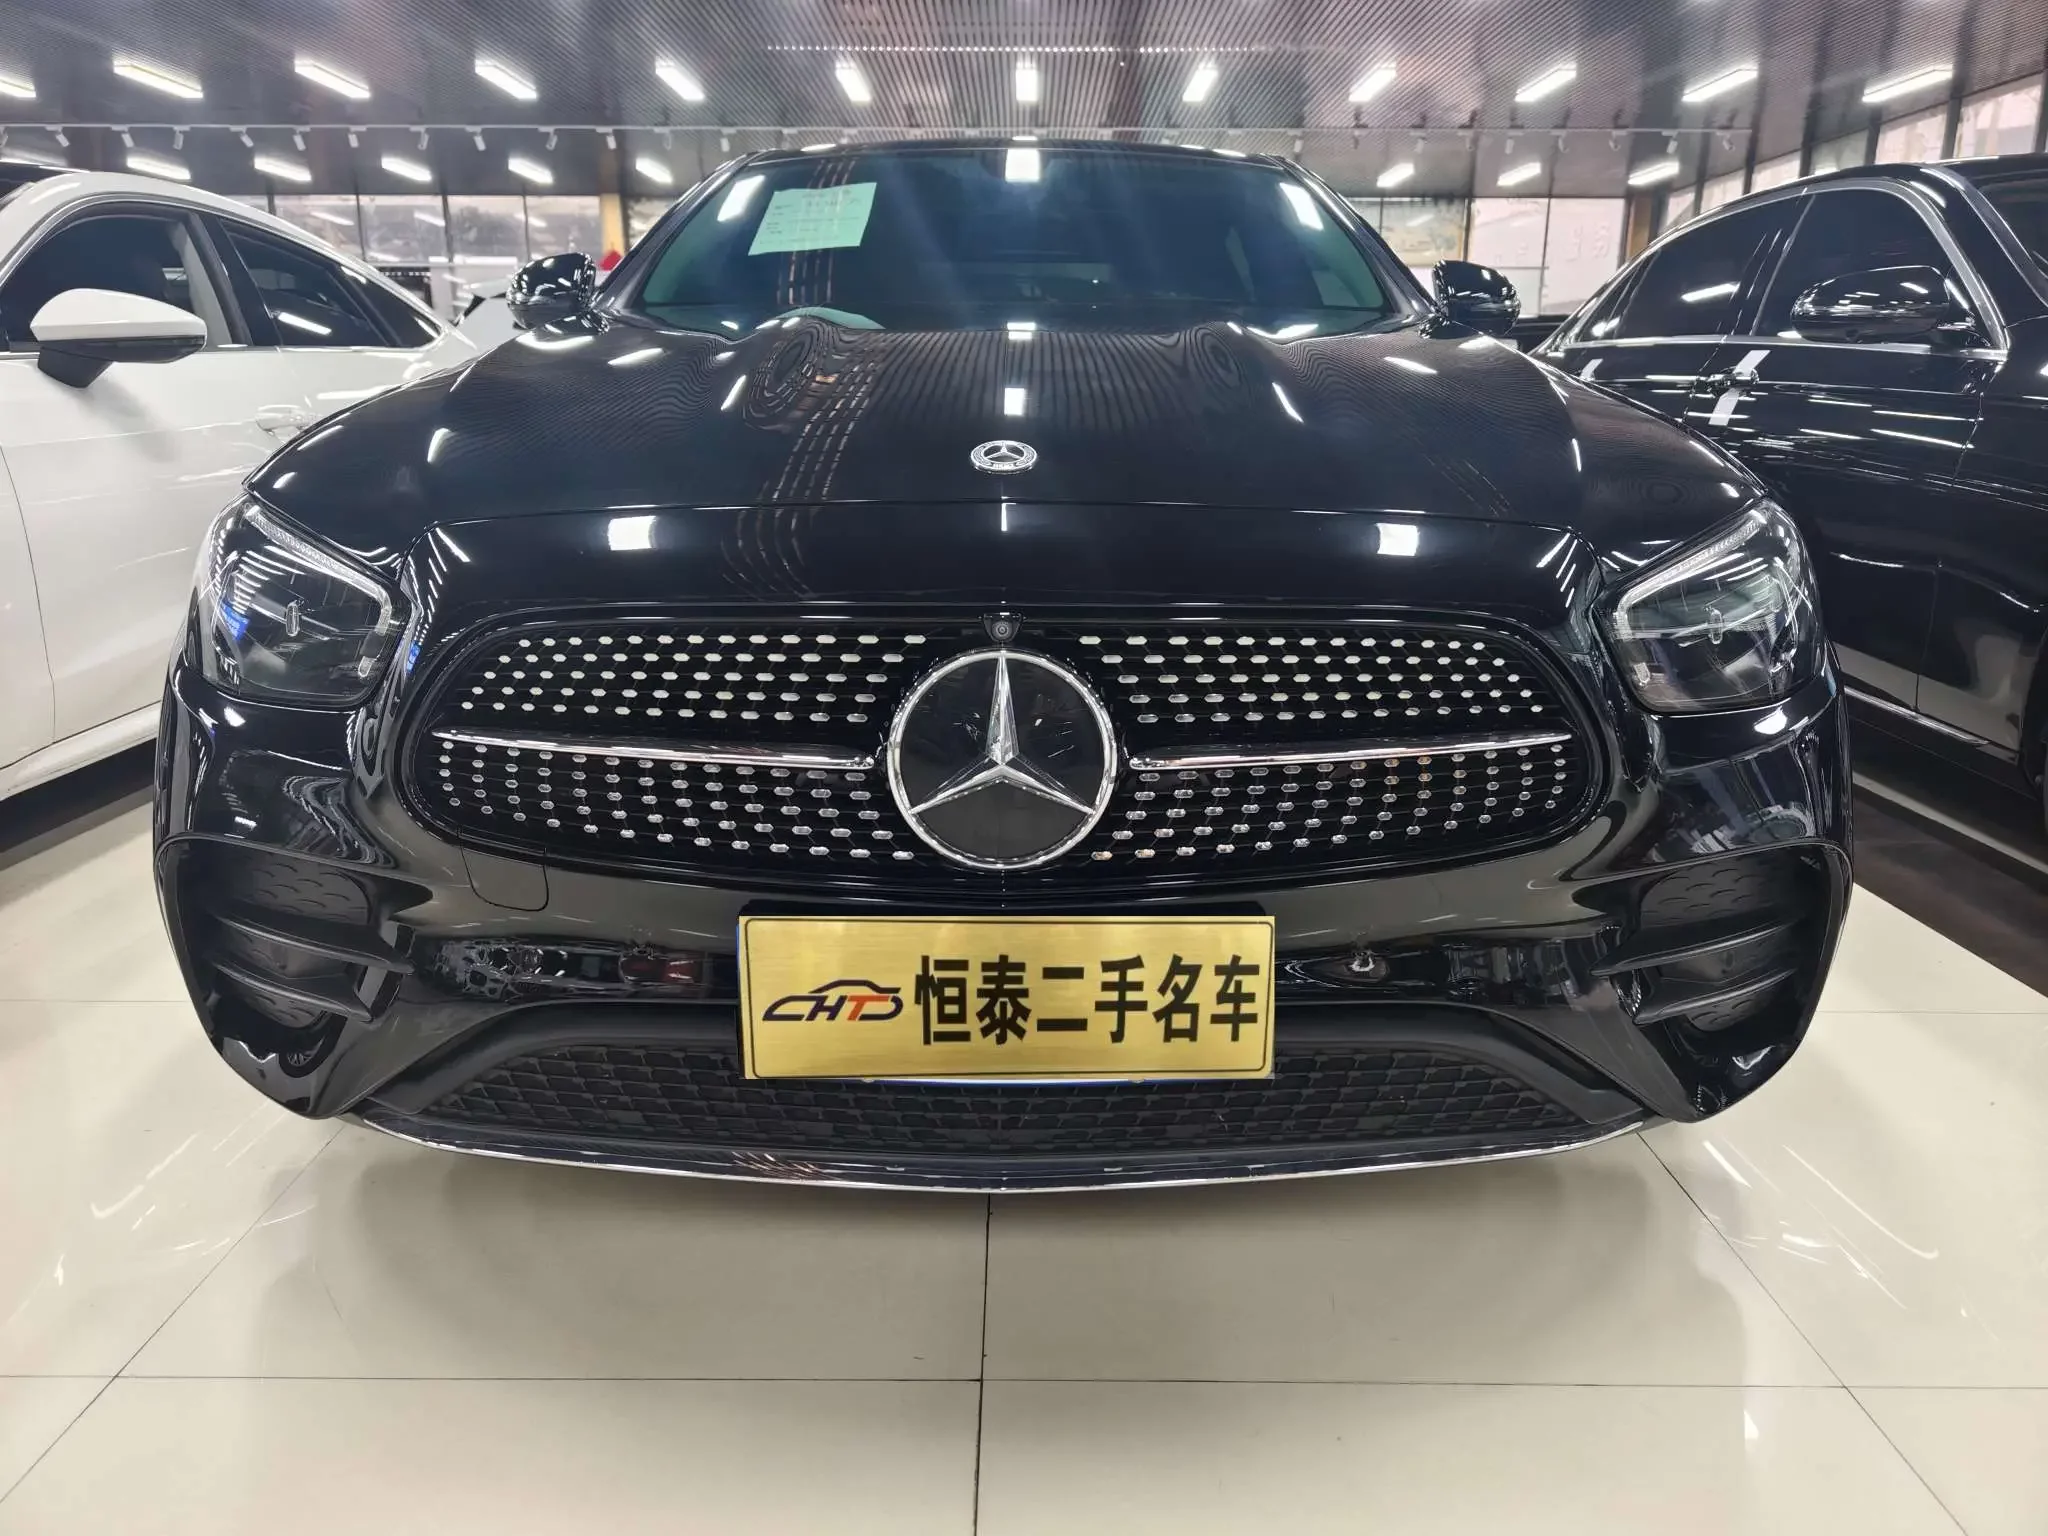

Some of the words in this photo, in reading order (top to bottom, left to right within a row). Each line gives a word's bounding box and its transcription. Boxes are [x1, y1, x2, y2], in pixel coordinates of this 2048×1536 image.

[914, 953, 1260, 1046] 恒泰二手名车
